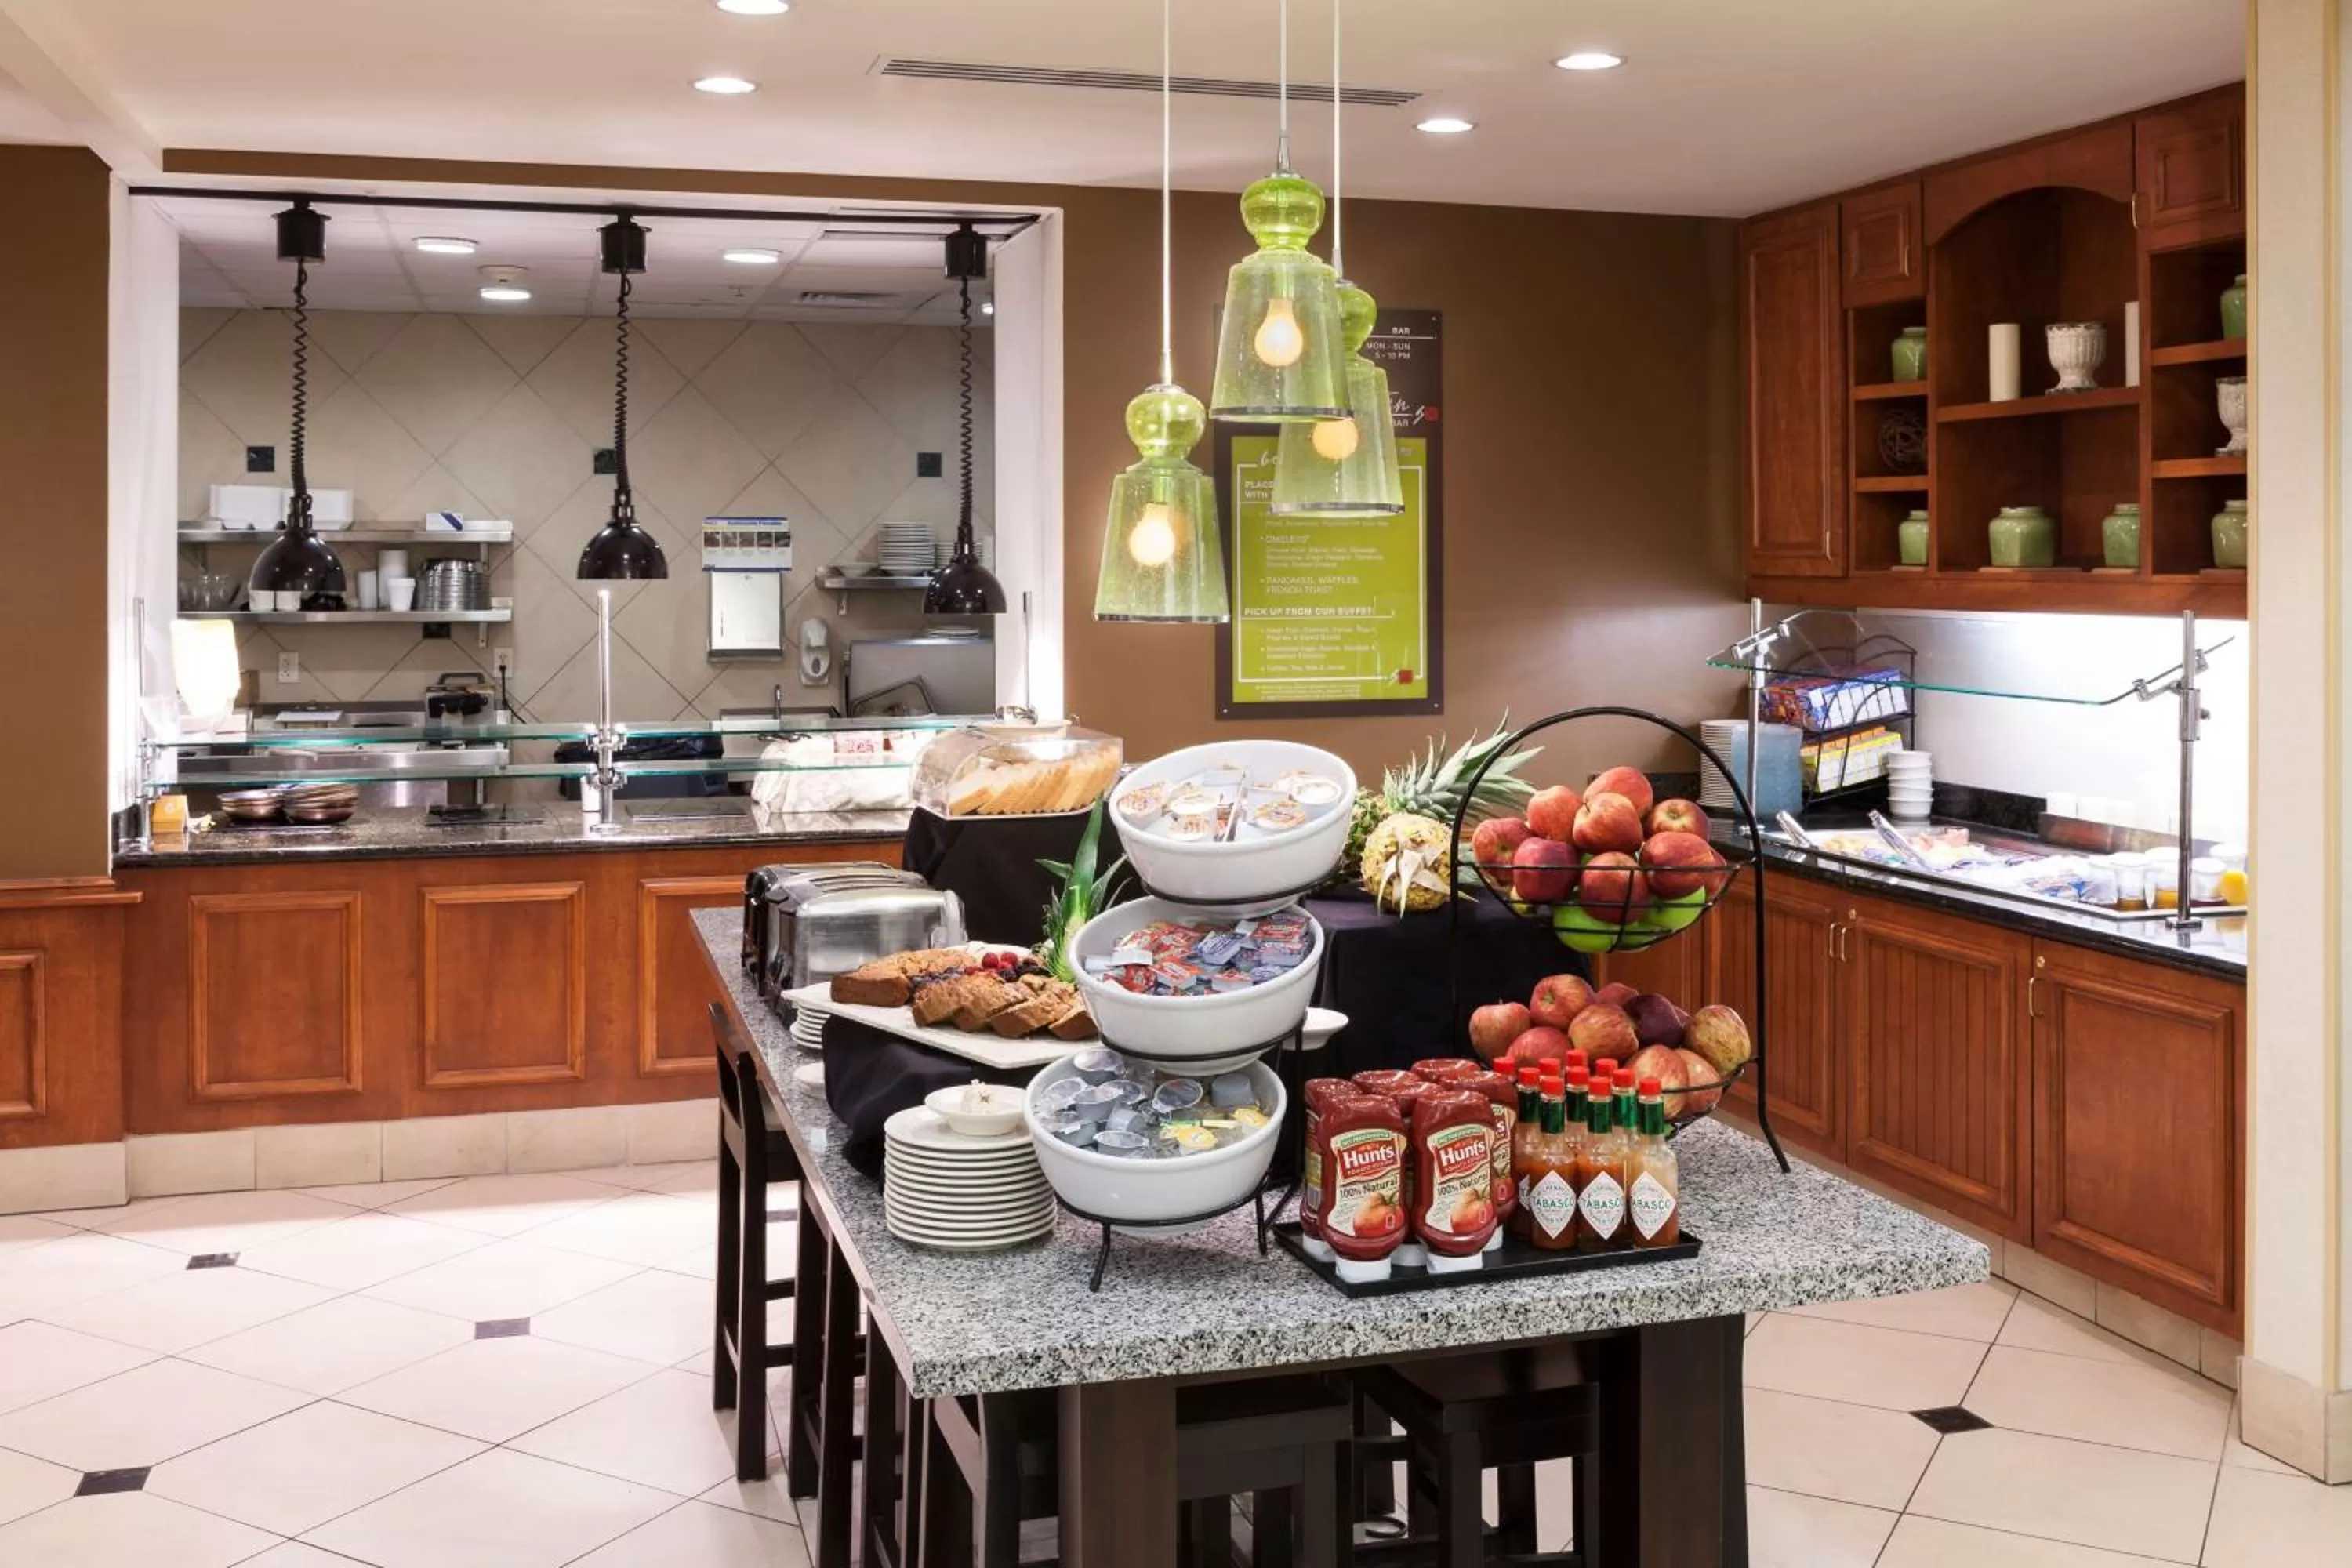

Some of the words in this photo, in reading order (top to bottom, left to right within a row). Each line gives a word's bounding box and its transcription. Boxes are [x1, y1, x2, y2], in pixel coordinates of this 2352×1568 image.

[1392, 342, 1410, 350] SUN
[1244, 491, 1268, 499] WITH
[1342, 1145, 1396, 1170] Hunt's
[1439, 1141, 1486, 1167] Hunt's
[1339, 1186, 1362, 1199] 100%
[1363, 1178, 1398, 1194] Natural
[1438, 1184, 1458, 1196] 100%
